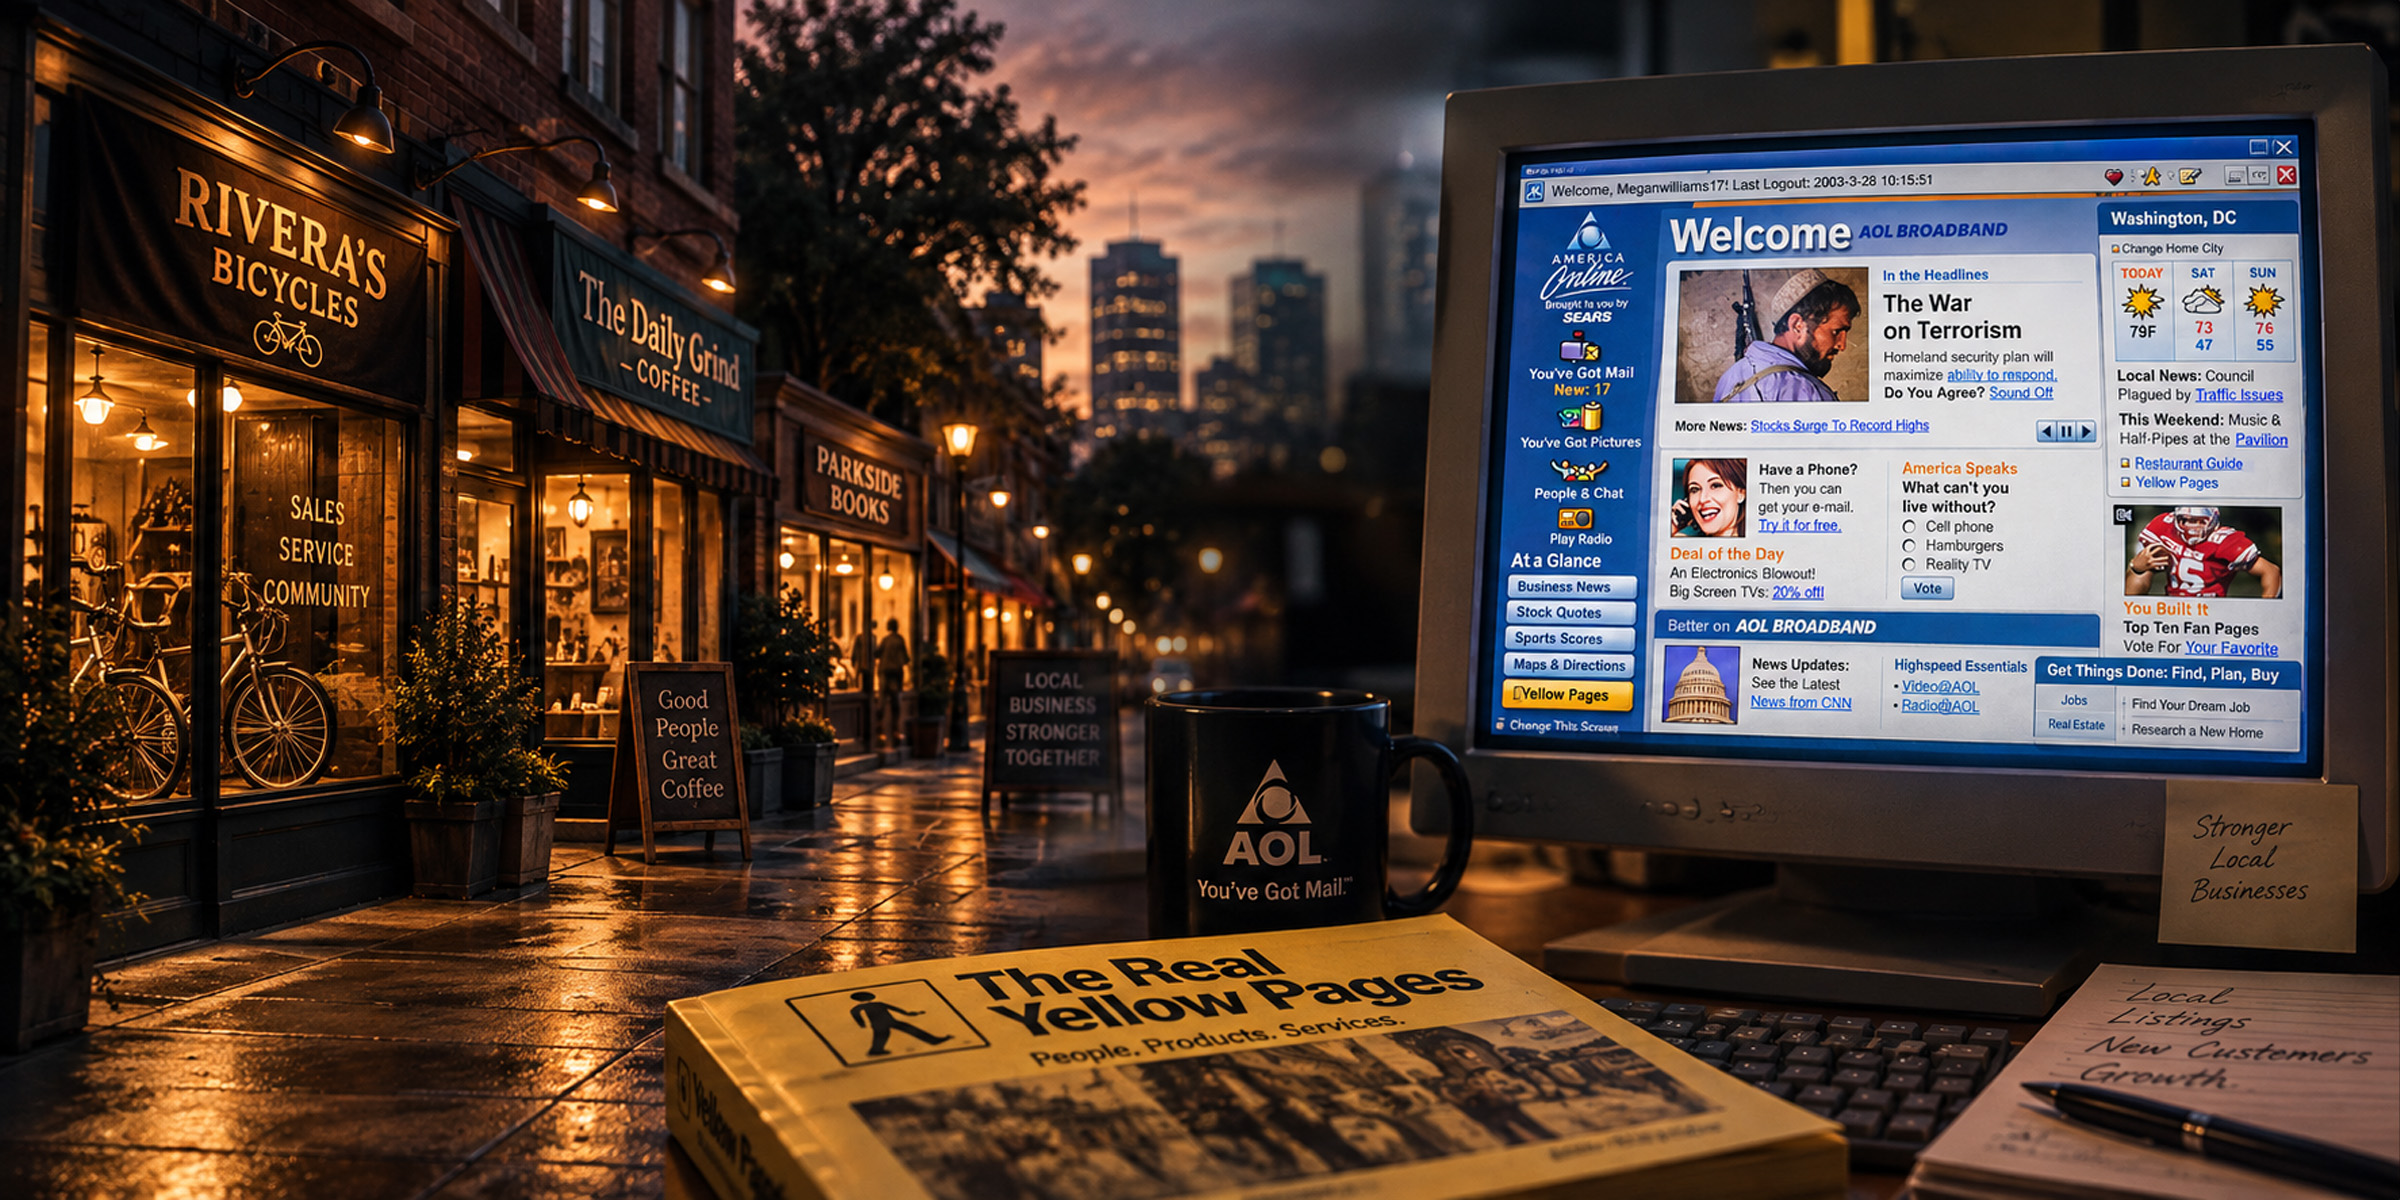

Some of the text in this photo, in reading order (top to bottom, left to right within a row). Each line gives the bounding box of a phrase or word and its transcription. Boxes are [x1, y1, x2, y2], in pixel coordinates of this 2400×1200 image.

[2111, 210, 2237, 228] Washington, DC
[175, 167, 387, 300] RIVERA'S
[1670, 216, 1852, 253] Welcome
[1858, 222, 2008, 239] AOL BROADBAND
[1552, 252, 1625, 265] AMERICA
[1883, 268, 1989, 281] In the Headlines
[2121, 268, 2164, 279] TODAY
[2191, 267, 2215, 278] SAT
[2250, 267, 2276, 278] SUN
[212, 246, 359, 328] BICYCLES
[1883, 294, 1972, 313] The War
[1563, 312, 1612, 323] SEARS
[579, 270, 740, 392] The Daily Grind
[1884, 321, 2022, 339] on Terrorism
[2130, 325, 2156, 338] 79F
[2195, 321, 2213, 334] 73
[2255, 322, 2274, 334] 76
[2195, 339, 2213, 351] 47
[1884, 351, 2053, 365] Homeland security plan will
[1530, 367, 1634, 380] You've Got Mail
[2118, 369, 2255, 382] Local News: Council
[1554, 383, 1611, 396] New: 17
[2118, 388, 2284, 403] Plagued by Traffic Issues
[2119, 413, 2281, 426] This Weekend: Music &
[817, 445, 902, 500] PARKSIDE
[1903, 461, 2018, 477] America Speaks
[1759, 483, 1842, 497] Then you can
[1902, 481, 2009, 497] What can't you
[2135, 476, 2219, 491] Yellow Pages
[290, 494, 345, 525] SALES
[830, 483, 889, 525] BOOKS
[1758, 501, 1854, 515] get your e-mail.
[1902, 500, 1996, 513] live without?
[1926, 521, 1994, 535] Cell phone
[279, 536, 354, 566] SERVICE
[1926, 540, 2004, 554] Hamburgers
[1671, 547, 1784, 564] Deal of the Day
[1926, 558, 1992, 573] Reality TV
[264, 579, 370, 608] COMMUNITY
[1518, 581, 1611, 593] Business News
[1914, 583, 1942, 594] Vote
[1517, 606, 1602, 619] Stock Quotes
[1668, 619, 1877, 635] Better on AOL BROADBAND
[2123, 621, 2259, 638] Top Ten Fan Pages
[1515, 632, 1603, 646] Sports Scores
[2123, 640, 2279, 657] Vote For Your Favorite
[1514, 659, 1626, 672] Maps & Directions
[1753, 658, 1849, 673] News Updates:
[1895, 658, 2028, 674] Highspeed Essentials
[1025, 672, 1084, 689] LOCAL
[2047, 664, 2279, 684] Get Things Done: Find, Plan, Buy
[1752, 677, 1840, 690] See the Latest
[658, 689, 710, 710] Good
[1010, 696, 1097, 714] BUSINESS
[1751, 695, 1852, 711] News from CNN
[2061, 694, 2088, 707] Jobs
[2132, 698, 2251, 714] Find Your Dream Job
[656, 717, 719, 743] People
[1006, 723, 1100, 741] STRONGER
[2049, 718, 2105, 731] Real Estate
[662, 749, 718, 770] Great
[1005, 749, 1100, 766] TOGETHER
[661, 778, 724, 799] Coffee
[2193, 814, 2293, 846] Stronger
[2209, 845, 2278, 870] Local
[1197, 879, 1258, 900] You've
[1265, 882, 1300, 900] Got
[2191, 878, 2309, 903] Businesses
[955, 948, 1286, 1001] The Real
[2126, 983, 2234, 1005] Local
[986, 968, 1485, 1037] Yellow Pages
[2108, 1008, 2252, 1035] Listings
[1029, 1016, 1406, 1068] People. Products. Services.
[2084, 1036, 2172, 1055] New
